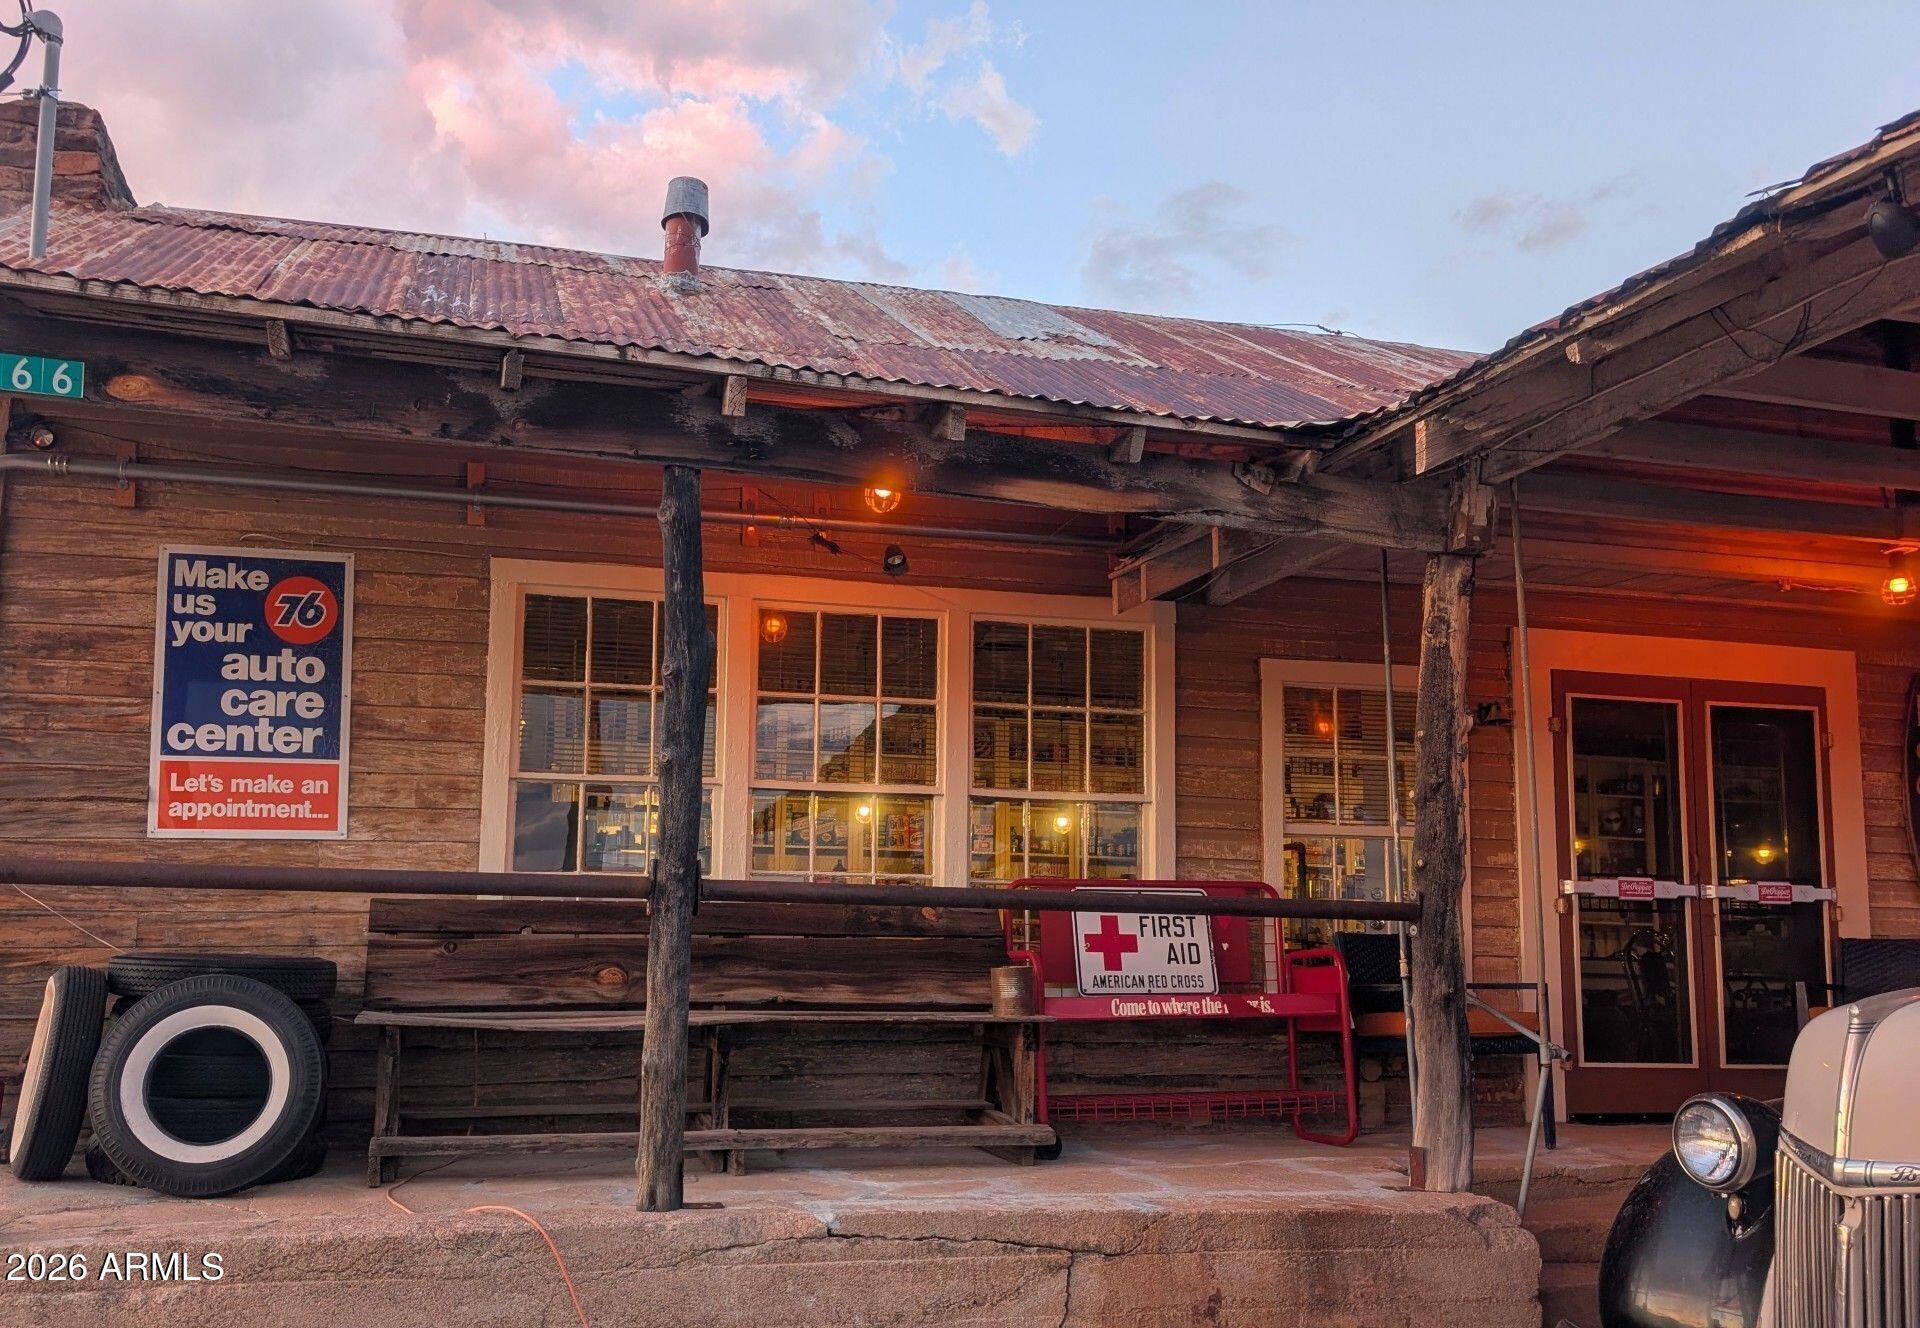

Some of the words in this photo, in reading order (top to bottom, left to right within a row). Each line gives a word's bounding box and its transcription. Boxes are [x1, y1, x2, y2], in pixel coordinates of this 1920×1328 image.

[174, 559, 270, 591] Make
[173, 593, 217, 616] us
[273, 590, 327, 628] 76
[172, 620, 253, 647] your
[221, 648, 326, 684] auto
[220, 688, 325, 719] care
[166, 717, 324, 754] center
[170, 772, 224, 793] Let's
[231, 774, 294, 794] make
[301, 779, 329, 794] an
[168, 798, 329, 821] appointment...
[1139, 915, 1196, 938] FIRST
[1167, 943, 1202, 965] AID
[1092, 974, 1145, 989] AMERICAN
[1148, 975, 1168, 989] RED
[1170, 975, 1205, 989] CROSS
[1111, 998, 1147, 1017] Come
[1147, 1000, 1160, 1015] to
[1202, 997, 1222, 1015] the
